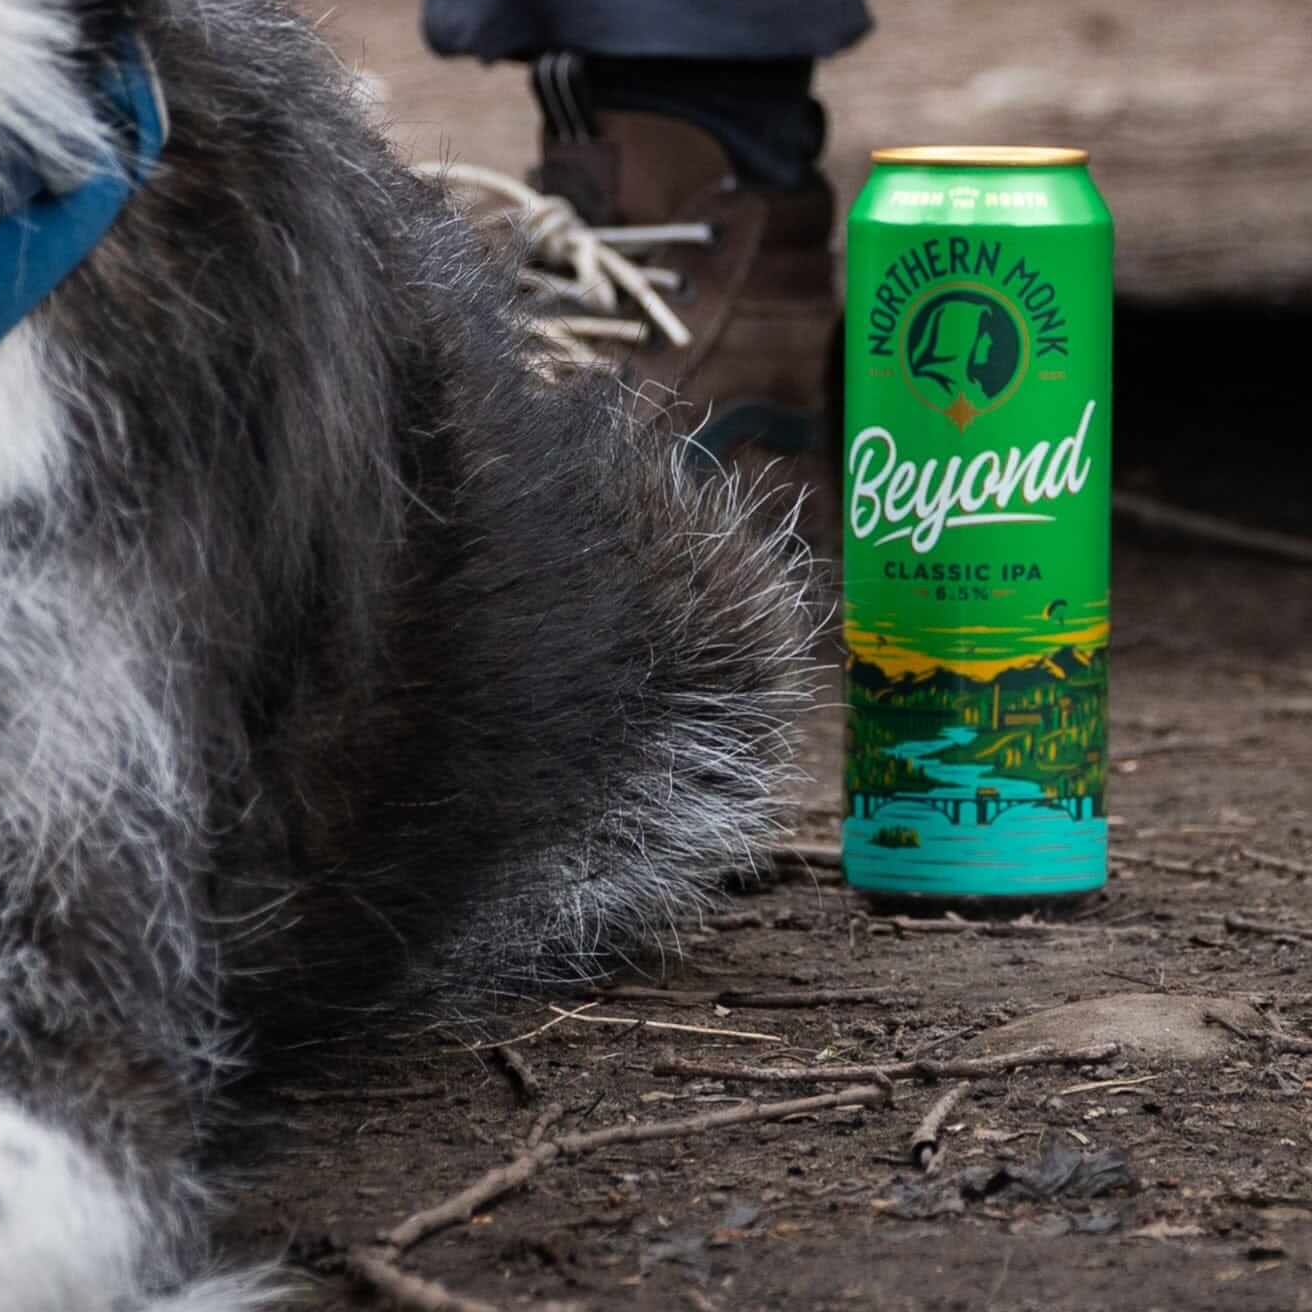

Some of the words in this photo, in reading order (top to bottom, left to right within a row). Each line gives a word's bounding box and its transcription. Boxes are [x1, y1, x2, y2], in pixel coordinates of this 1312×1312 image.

[868, 236, 1001, 357] NORTHERN
[1002, 255, 1069, 358] MONK
[849, 399, 1096, 554] Beyond
[884, 560, 992, 582] CLASSIC
[1001, 563, 1043, 582] IPA
